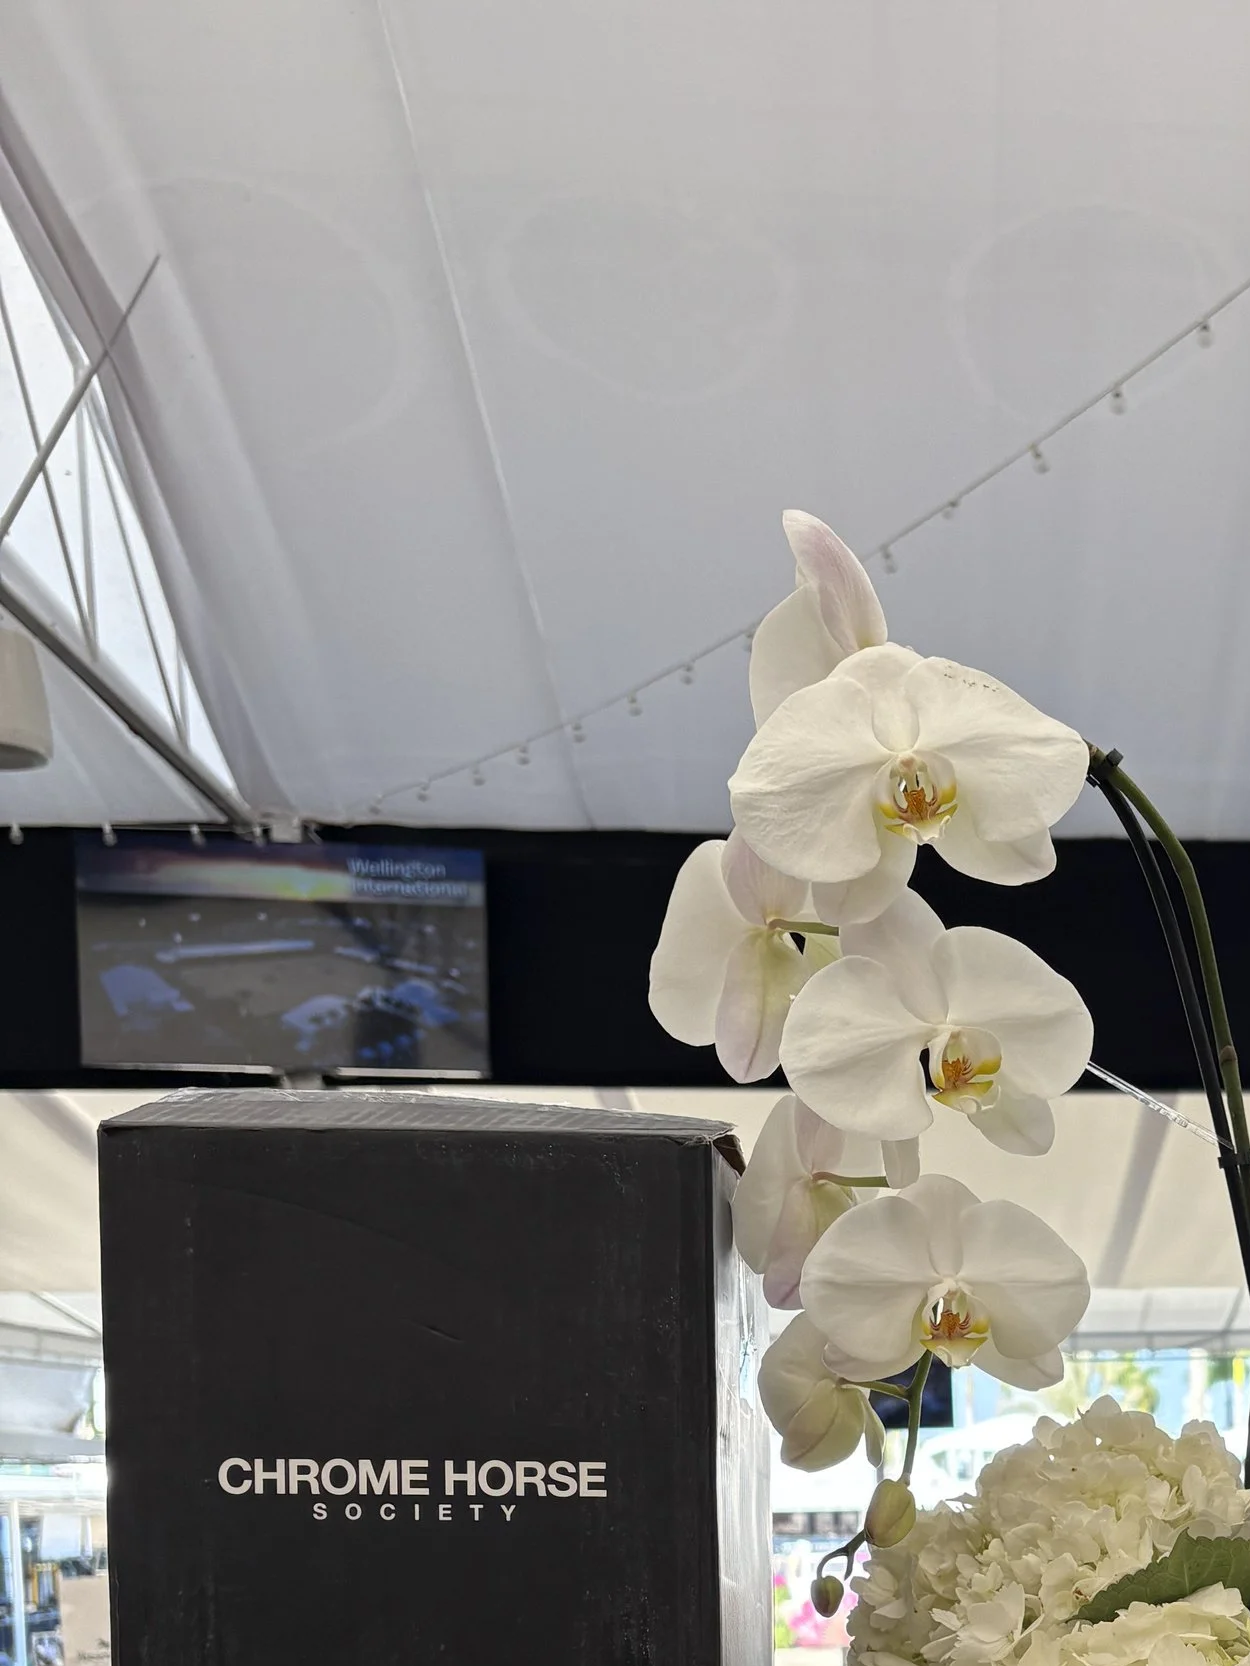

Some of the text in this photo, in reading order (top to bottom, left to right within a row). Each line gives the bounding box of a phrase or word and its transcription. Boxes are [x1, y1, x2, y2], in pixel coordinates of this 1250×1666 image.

[346, 857, 446, 879] Wellington
[218, 1457, 608, 1498] CHROME HORSE
[312, 1502, 517, 1522] SOCIETY
